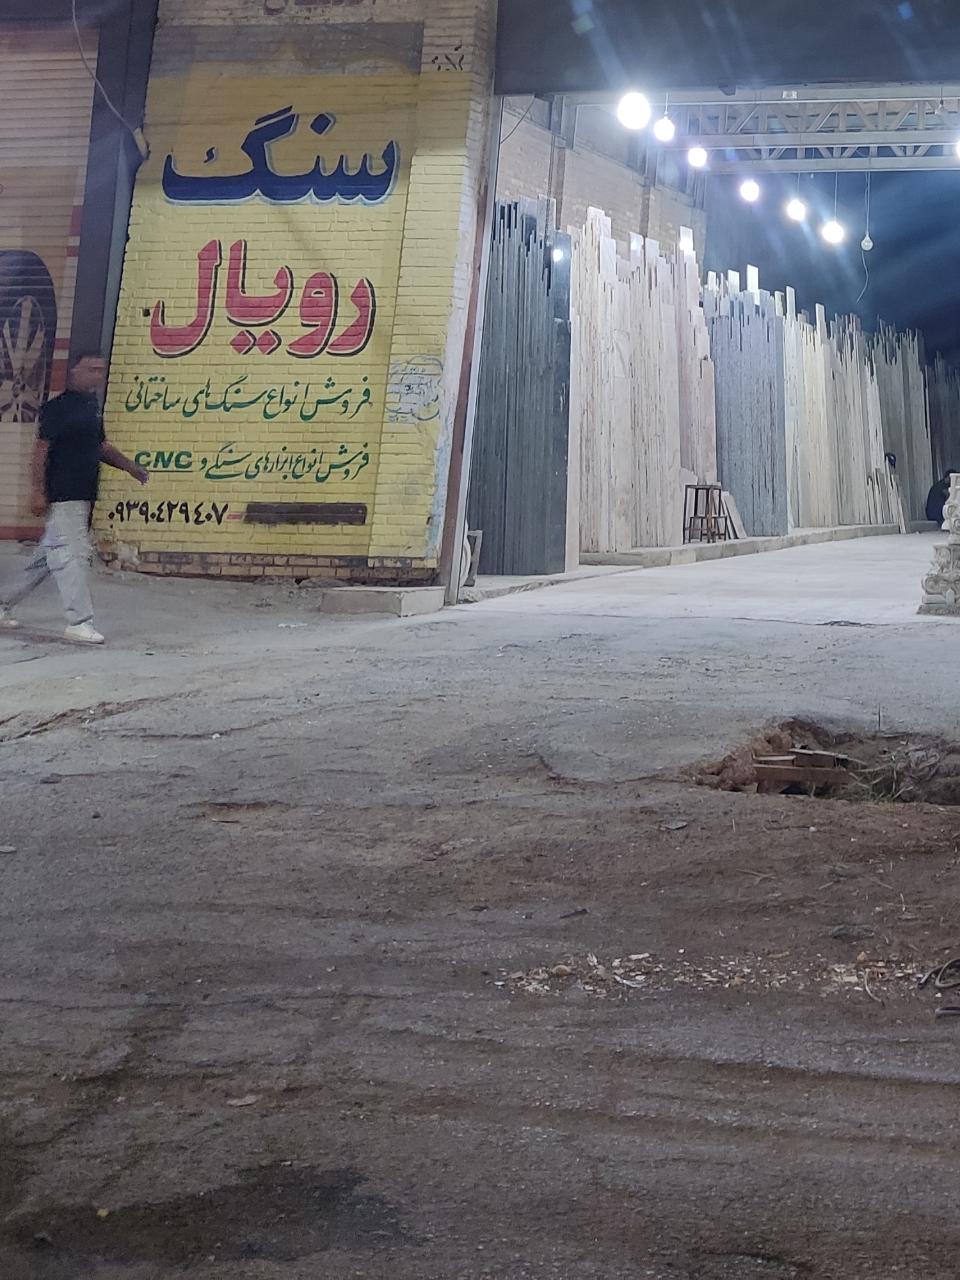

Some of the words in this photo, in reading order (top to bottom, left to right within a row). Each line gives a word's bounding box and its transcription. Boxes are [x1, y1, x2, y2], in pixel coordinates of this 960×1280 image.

[161, 104, 400, 206] سنگ
[148, 237, 376, 359] رویال
[124, 375, 181, 412] ساختمانی
[262, 380, 310, 420] انواع
[300, 376, 373, 421] فروش
[134, 450, 193, 470] CNC
[291, 448, 324, 480] انواع
[315, 442, 370, 483] فروش
